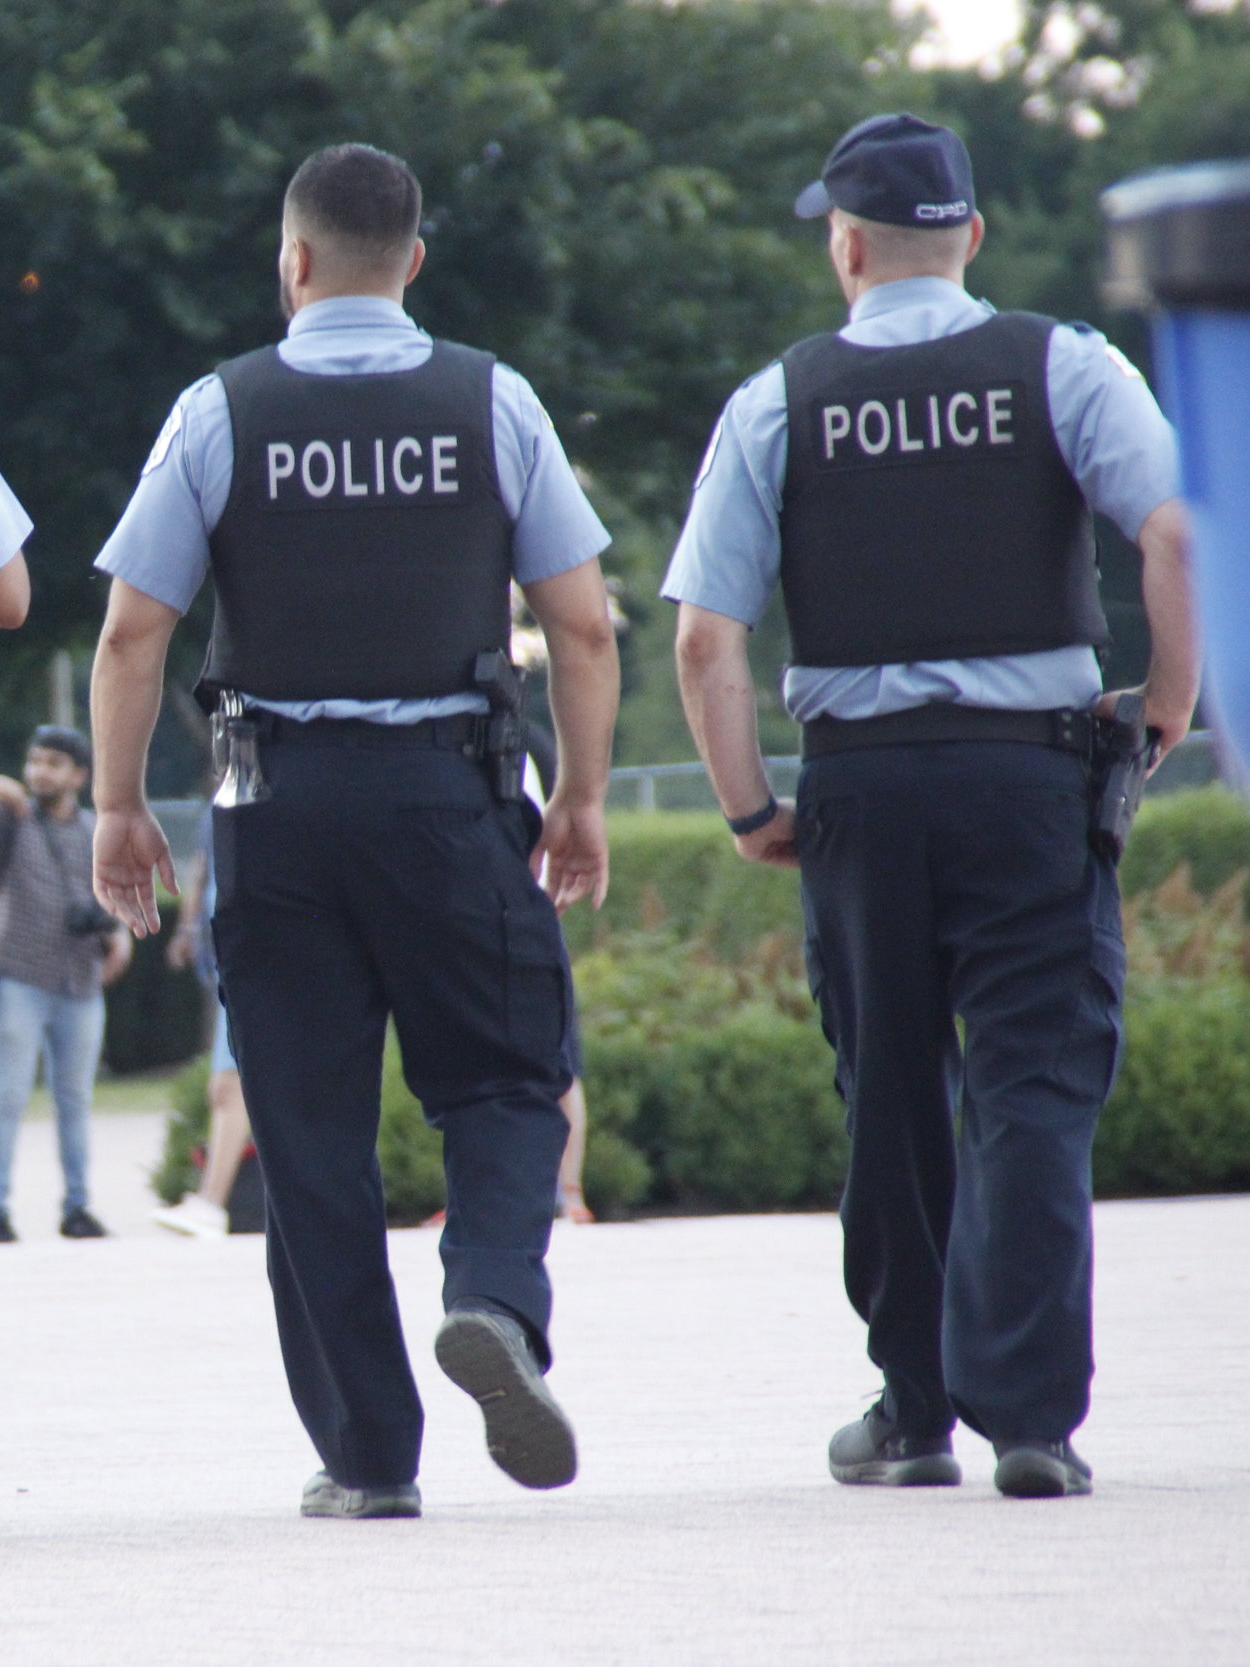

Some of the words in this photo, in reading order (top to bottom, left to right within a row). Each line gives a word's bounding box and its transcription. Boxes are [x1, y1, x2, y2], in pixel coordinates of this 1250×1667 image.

[916, 200, 969, 220] CPD
[822, 388, 1014, 460] POLICE
[266, 434, 460, 500] POLICE
